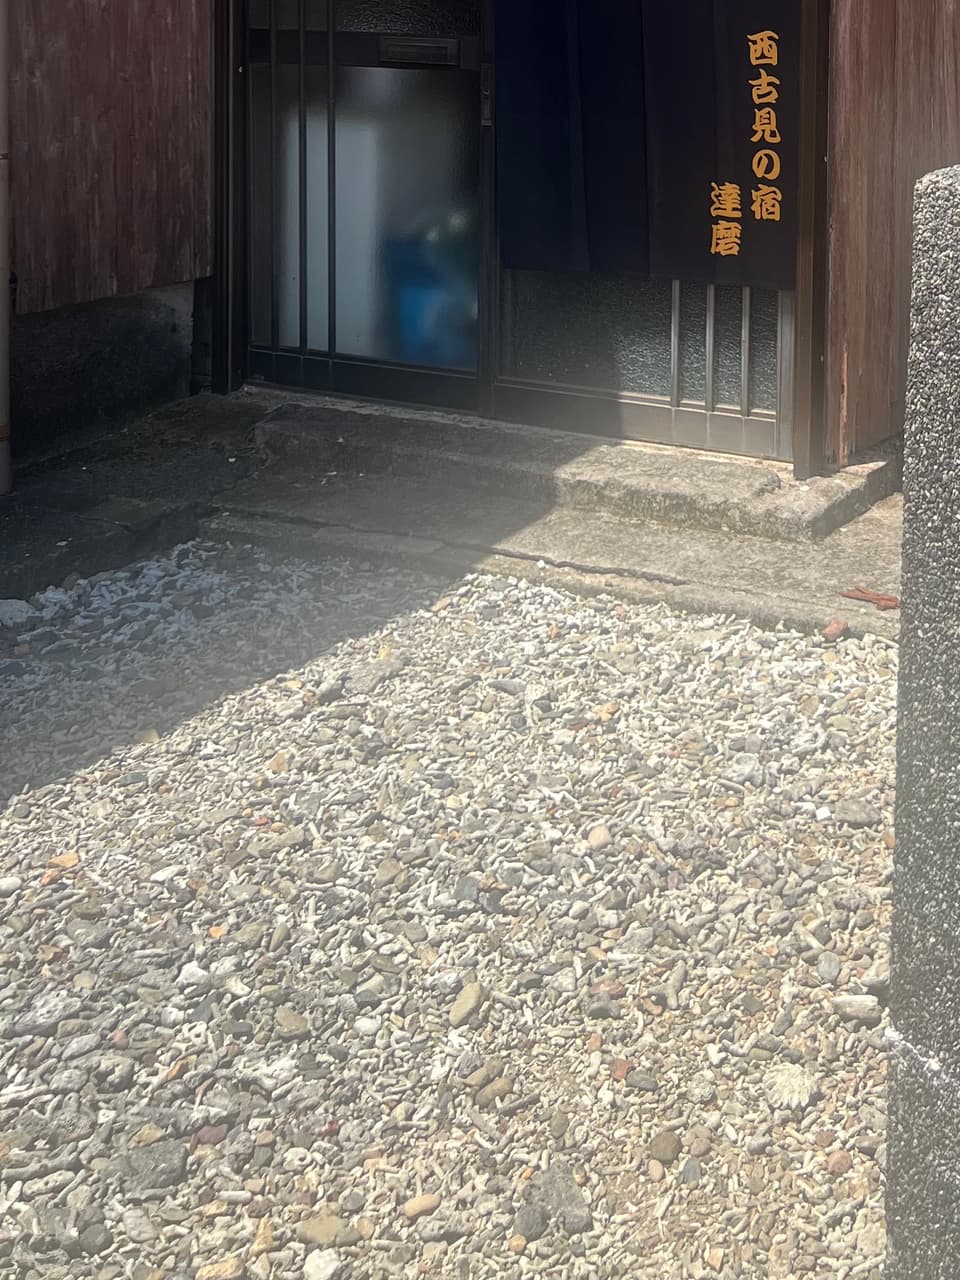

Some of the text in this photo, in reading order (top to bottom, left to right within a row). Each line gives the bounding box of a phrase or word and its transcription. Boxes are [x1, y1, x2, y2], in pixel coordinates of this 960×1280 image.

[746, 31, 783, 221] 西古見の宿
[709, 181, 742, 256] 達磨
